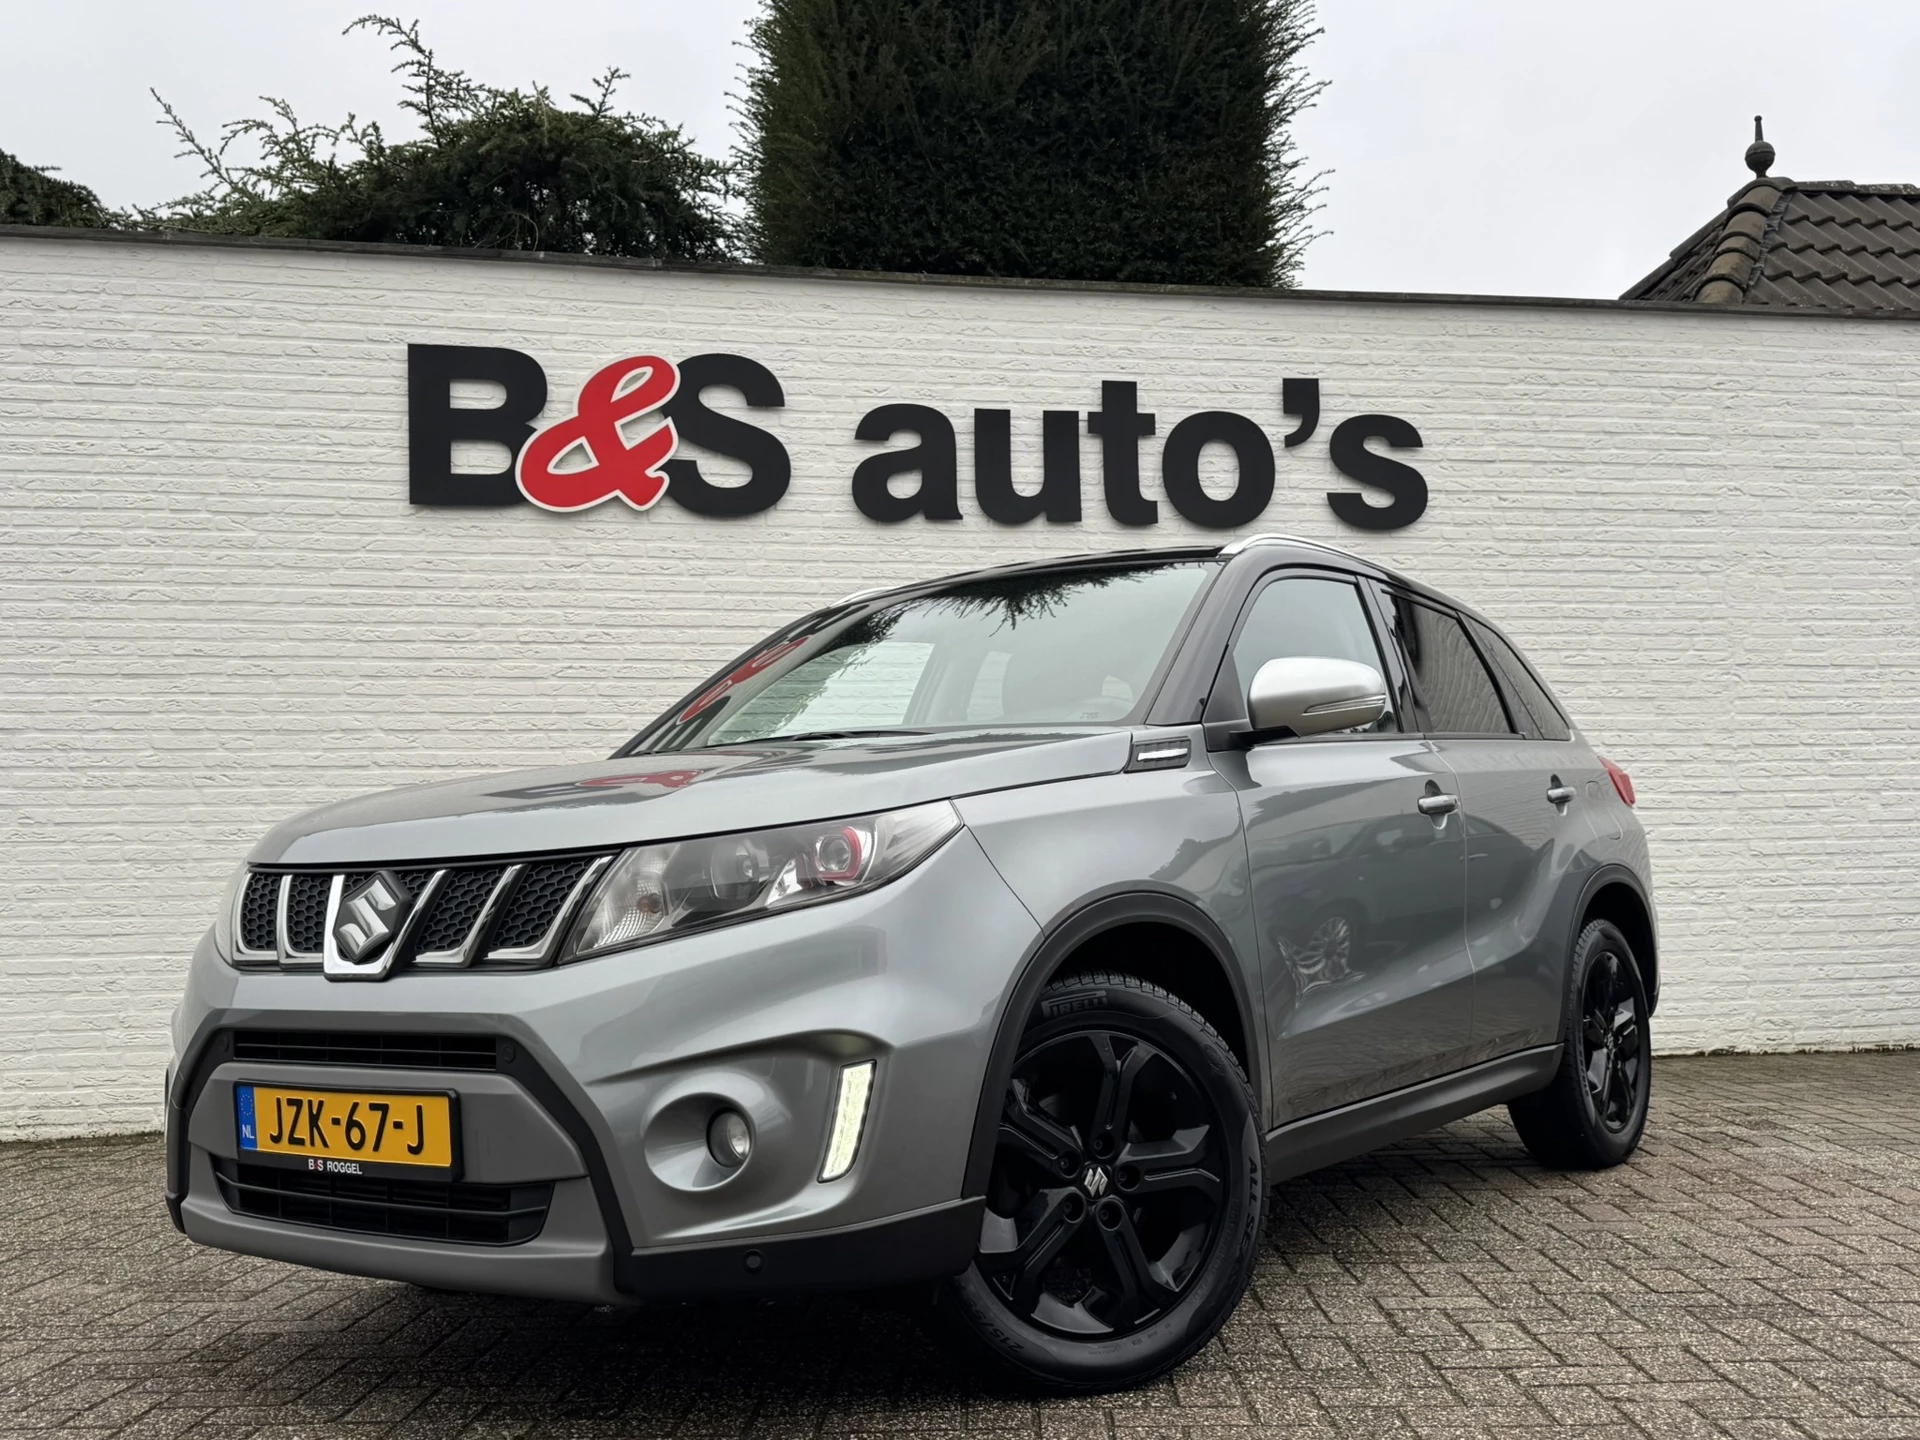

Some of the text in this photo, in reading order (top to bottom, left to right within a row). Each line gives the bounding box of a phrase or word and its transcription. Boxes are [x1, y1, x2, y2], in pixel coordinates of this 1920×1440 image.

[407, 343, 1429, 530] B&S auto's
[242, 1124, 255, 1139] NL
[269, 1097, 424, 1155] JZK-67-J
[327, 1161, 363, 1175] ROGGEL
